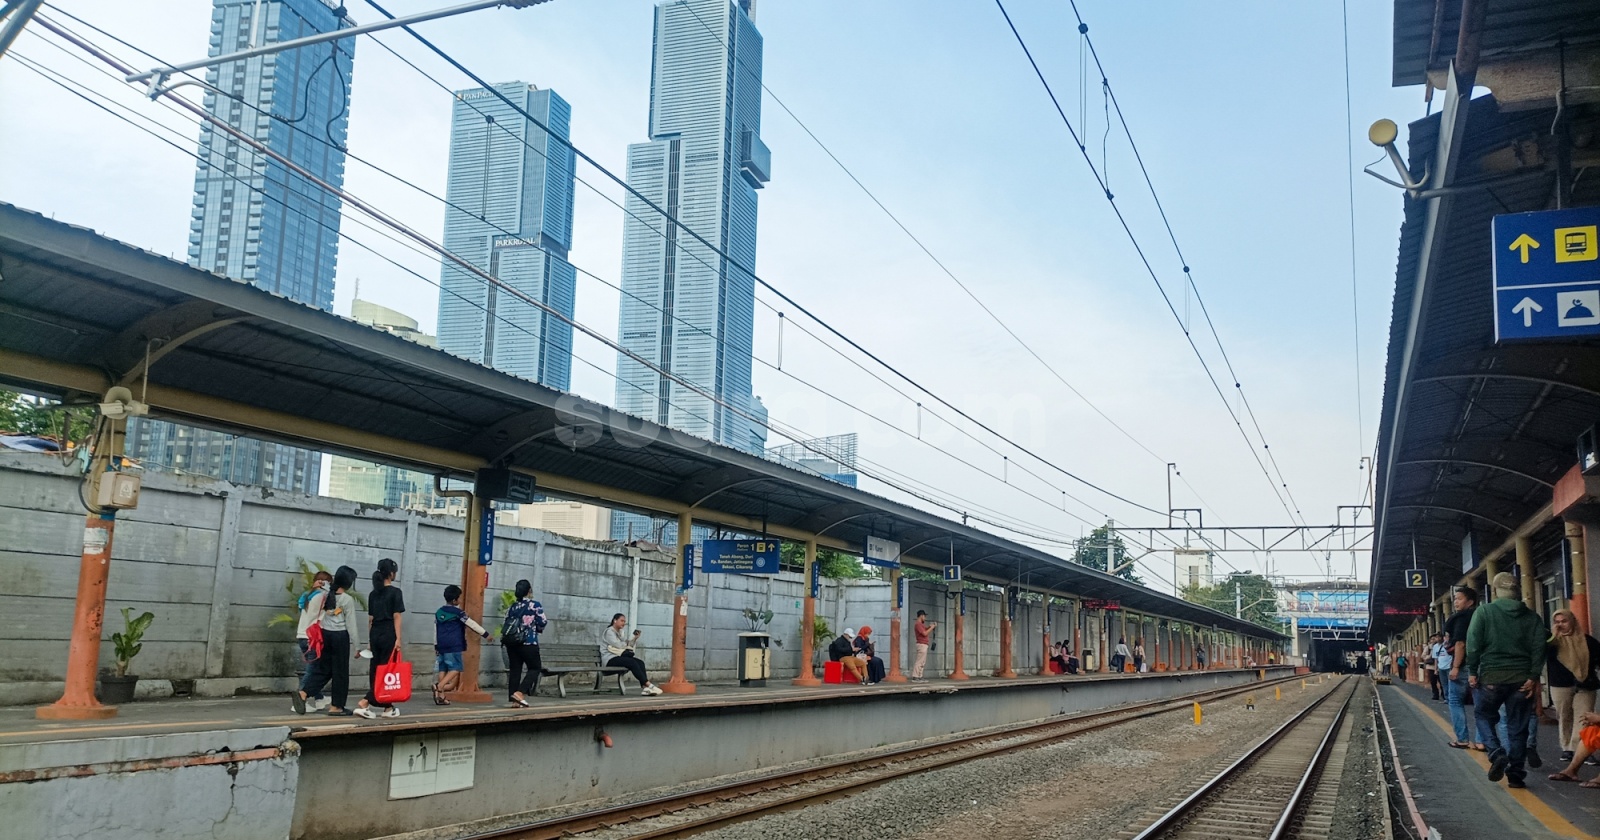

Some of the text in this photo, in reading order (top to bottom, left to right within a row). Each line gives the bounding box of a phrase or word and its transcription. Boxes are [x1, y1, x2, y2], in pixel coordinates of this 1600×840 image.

[495, 237, 536, 247] PARKROYAL
[948, 568, 954, 578] 1
[1412, 573, 1423, 586] 2
[384, 672, 400, 685] O!
